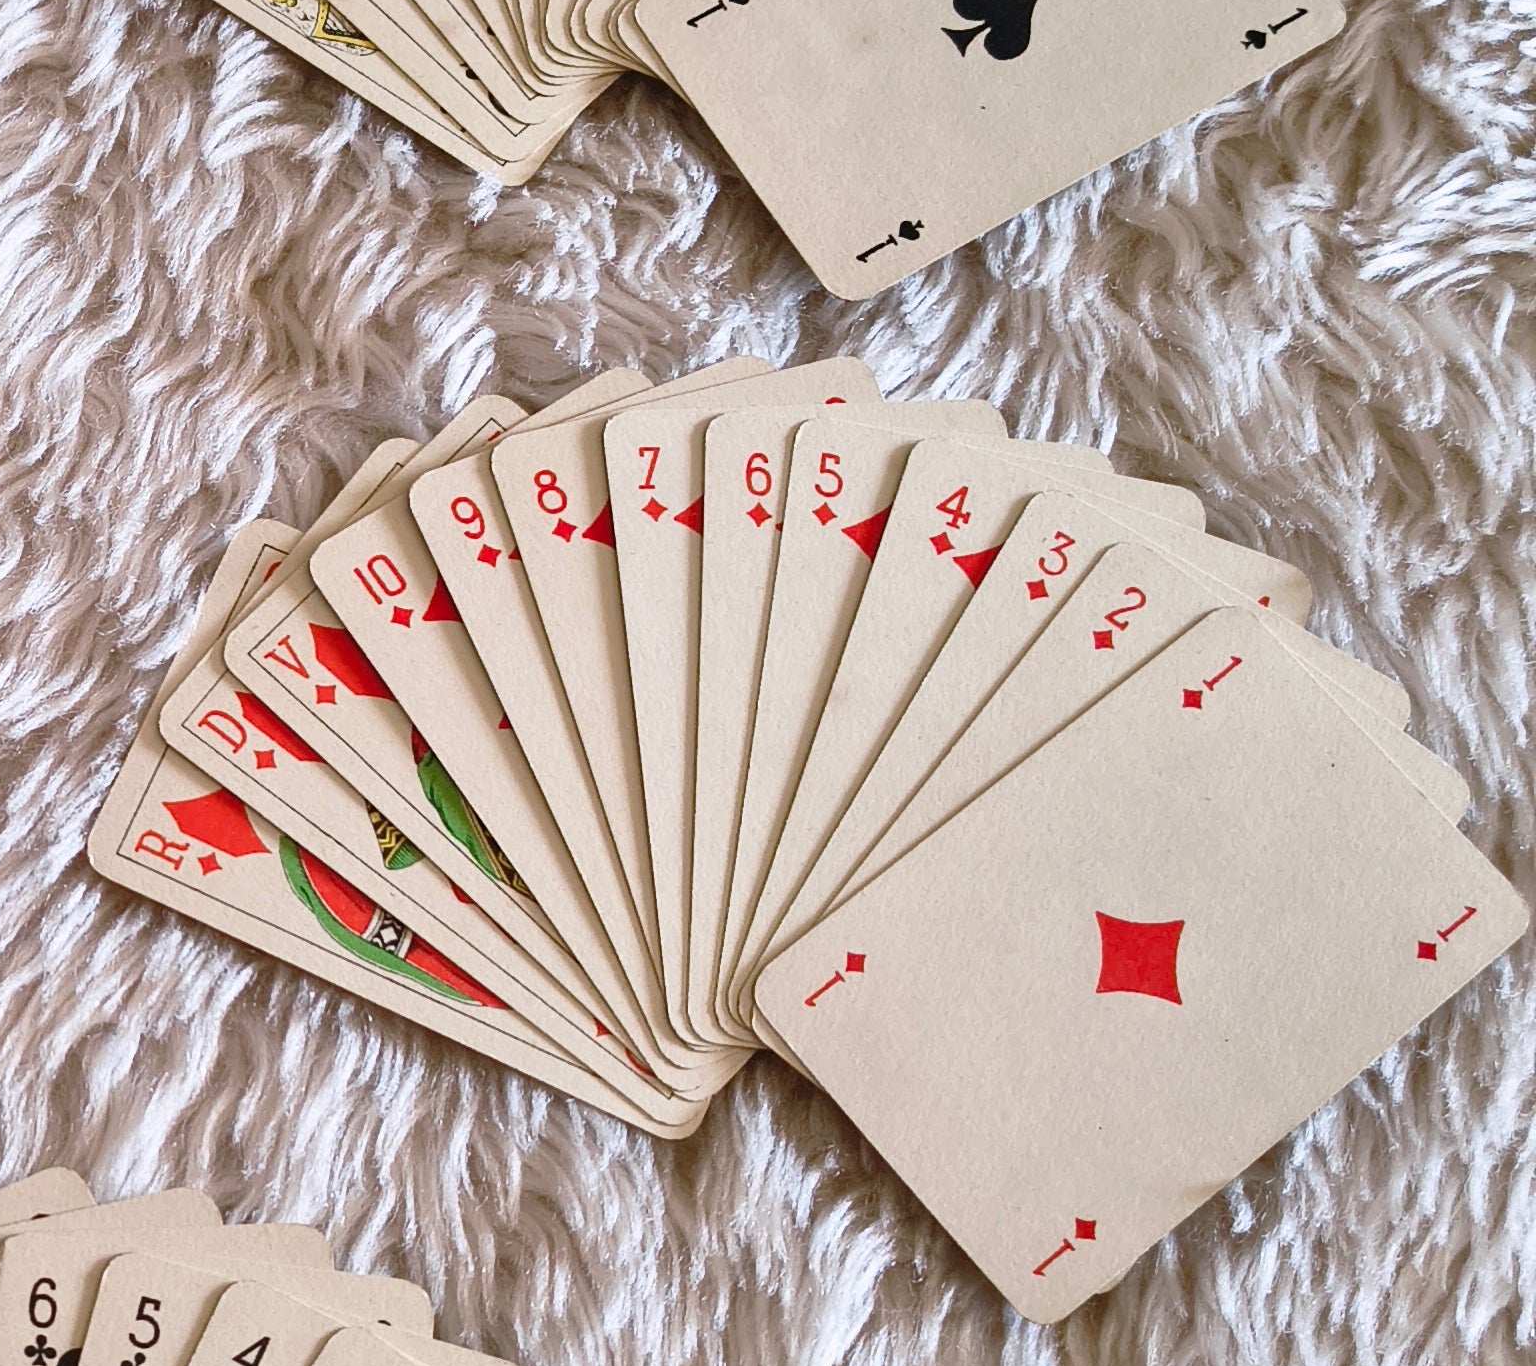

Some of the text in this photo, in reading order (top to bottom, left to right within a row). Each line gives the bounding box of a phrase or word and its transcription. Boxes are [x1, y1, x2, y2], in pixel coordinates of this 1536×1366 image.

[638, 446, 660, 491] 7
[744, 452, 772, 498] 6
[814, 452, 844, 499] 5
[532, 469, 568, 516] 8
[935, 486, 971, 530] 4
[449, 496, 486, 541] 9
[1037, 532, 1075, 577] 3
[352, 554, 407, 607] 10
[1104, 587, 1146, 632] 2
[262, 635, 310, 680] V
[196, 709, 248, 755] D
[133, 830, 190, 872] R
[28, 1277, 57, 1329] 6
[128, 1296, 161, 1350] 5
